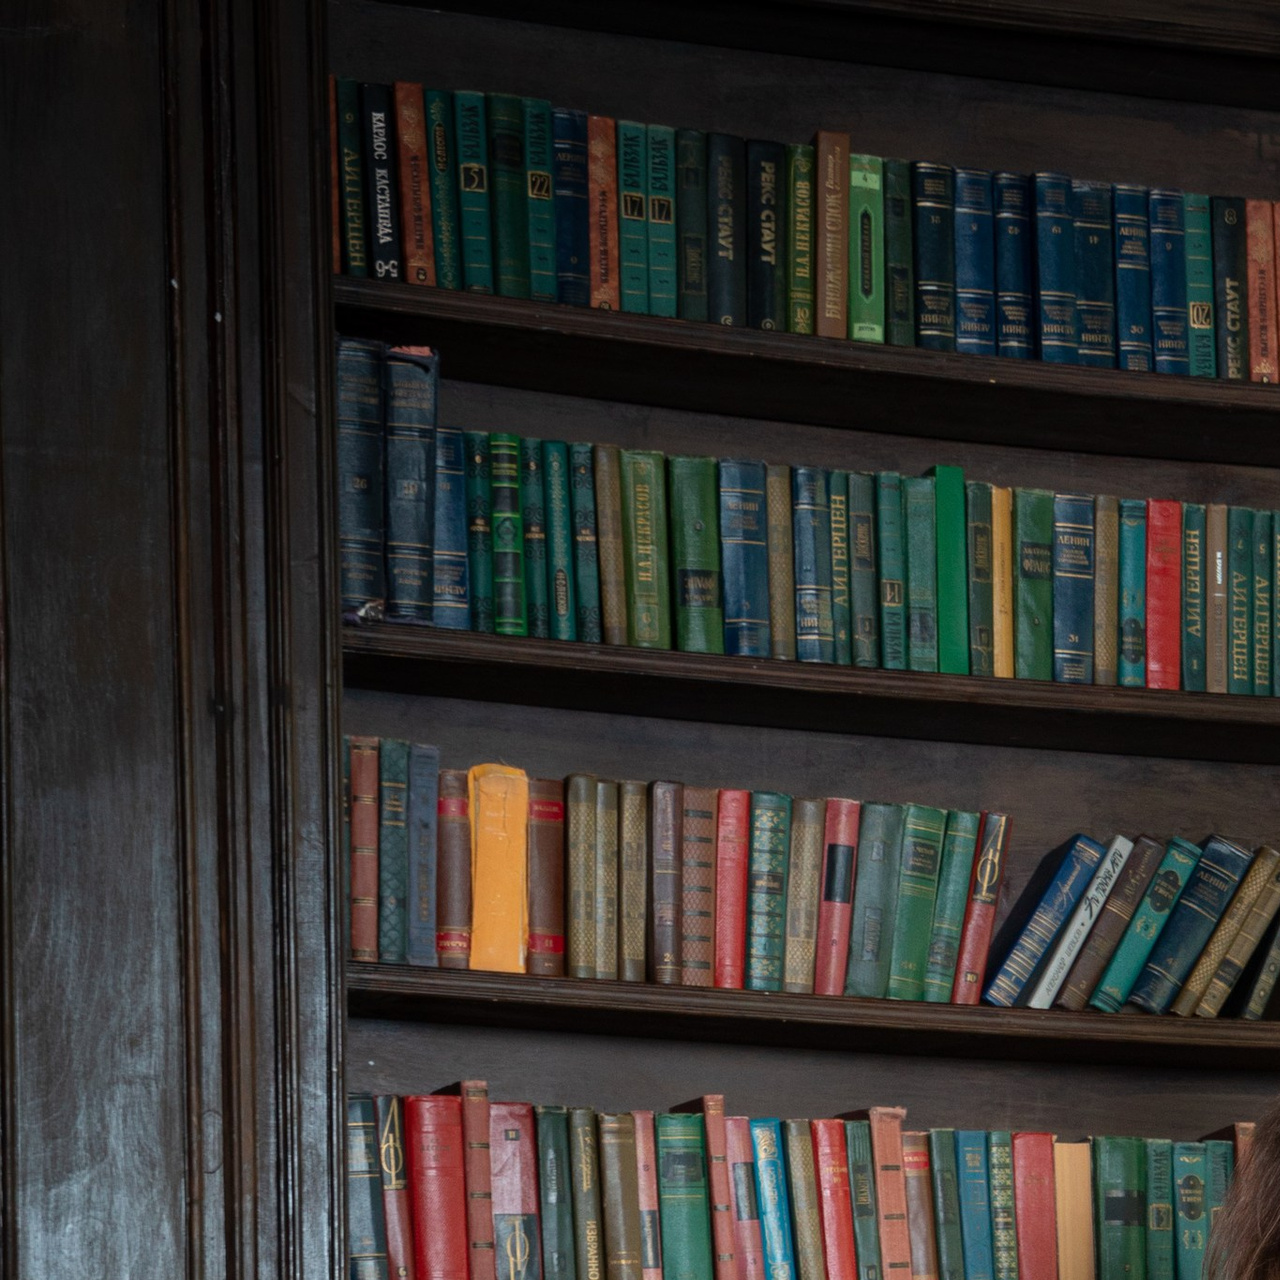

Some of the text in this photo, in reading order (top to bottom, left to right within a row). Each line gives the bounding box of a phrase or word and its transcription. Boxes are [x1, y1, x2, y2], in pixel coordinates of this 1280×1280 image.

[371, 112, 393, 244] КАРЛОС КАСТАНЕДА
[532, 175, 549, 195] 22
[625, 196, 643, 216] 17
[652, 199, 670, 220] 17
[717, 156, 734, 261] РЕКС СТАУТ
[760, 161, 776, 265] РЕКС СТАУТ
[825, 192, 842, 319] БЕНДЖАМИН СПОК
[1193, 306, 1210, 323] 20
[1224, 276, 1242, 378] РЕКС СТАУТ
[1195, 334, 1210, 377] БАЛЬЗА
[1057, 535, 1089, 547] ЛЕНИН
